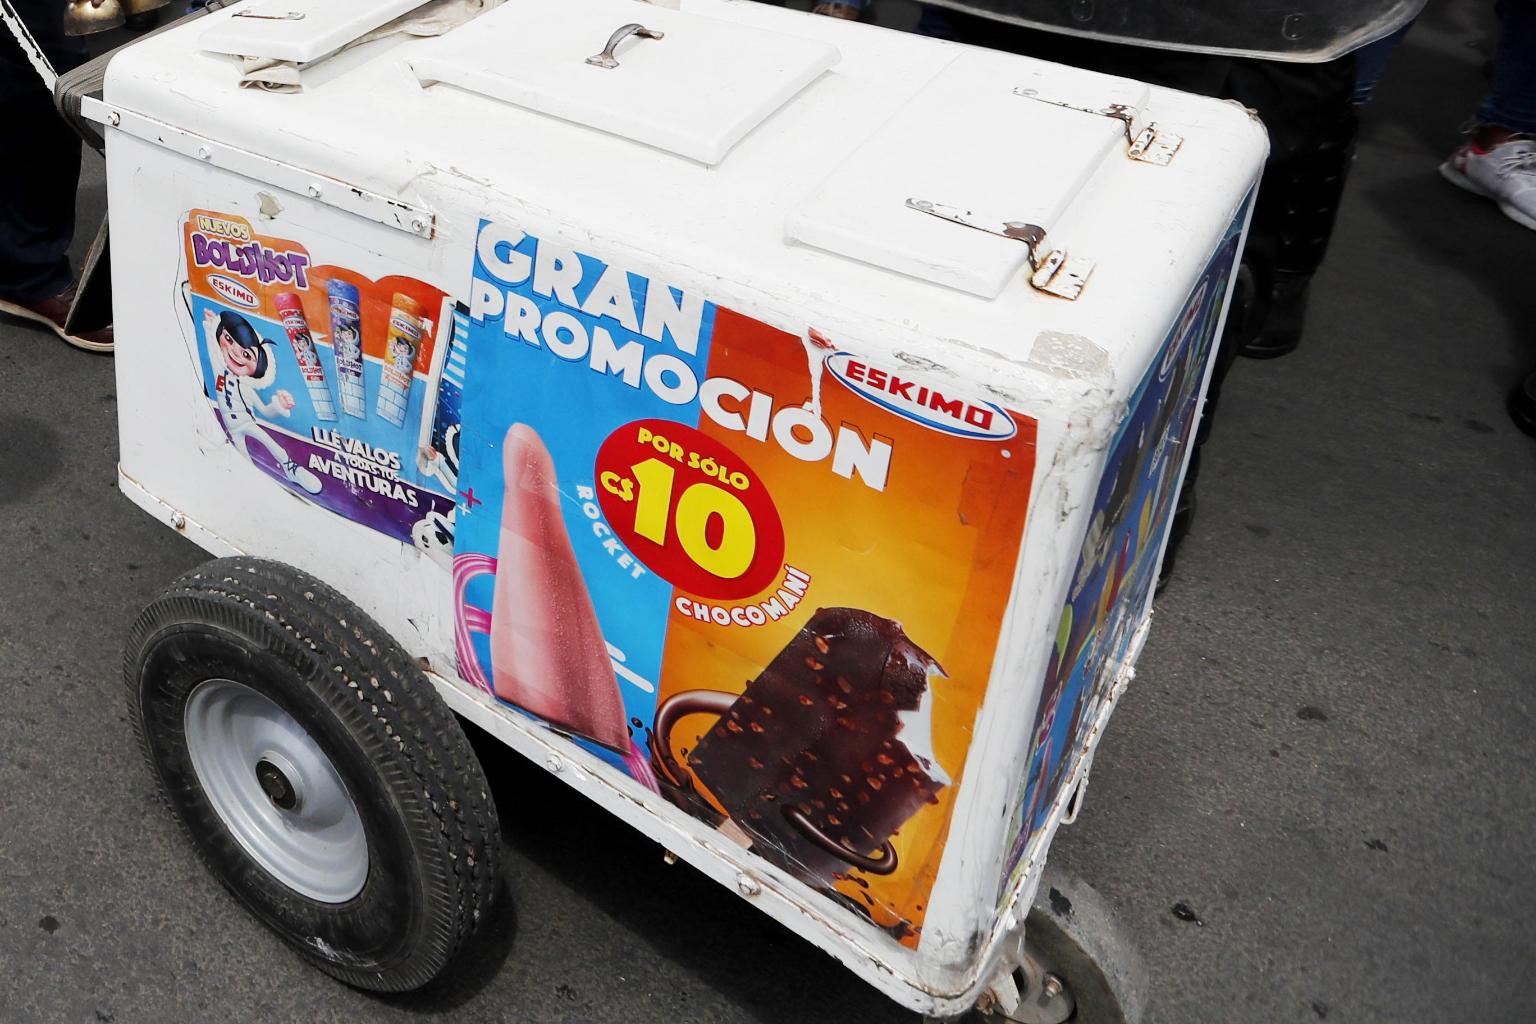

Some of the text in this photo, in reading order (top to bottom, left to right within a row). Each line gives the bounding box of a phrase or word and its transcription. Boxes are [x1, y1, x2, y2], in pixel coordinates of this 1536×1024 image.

[198, 215, 250, 240] NUEVOS
[212, 277, 255, 305] ESKIMO
[476, 219, 706, 357] GRAN
[470, 276, 892, 492] PROMOCIÓN
[845, 359, 994, 431] ESKIMO
[311, 425, 401, 470] LLÉVALOS
[334, 452, 401, 483] A TODAS TUS
[638, 426, 750, 490] POR SÓLO
[308, 453, 419, 508] AVENTURAS
[575, 484, 647, 580] ROCKET
[674, 563, 812, 628] CHOCOMANÍ
